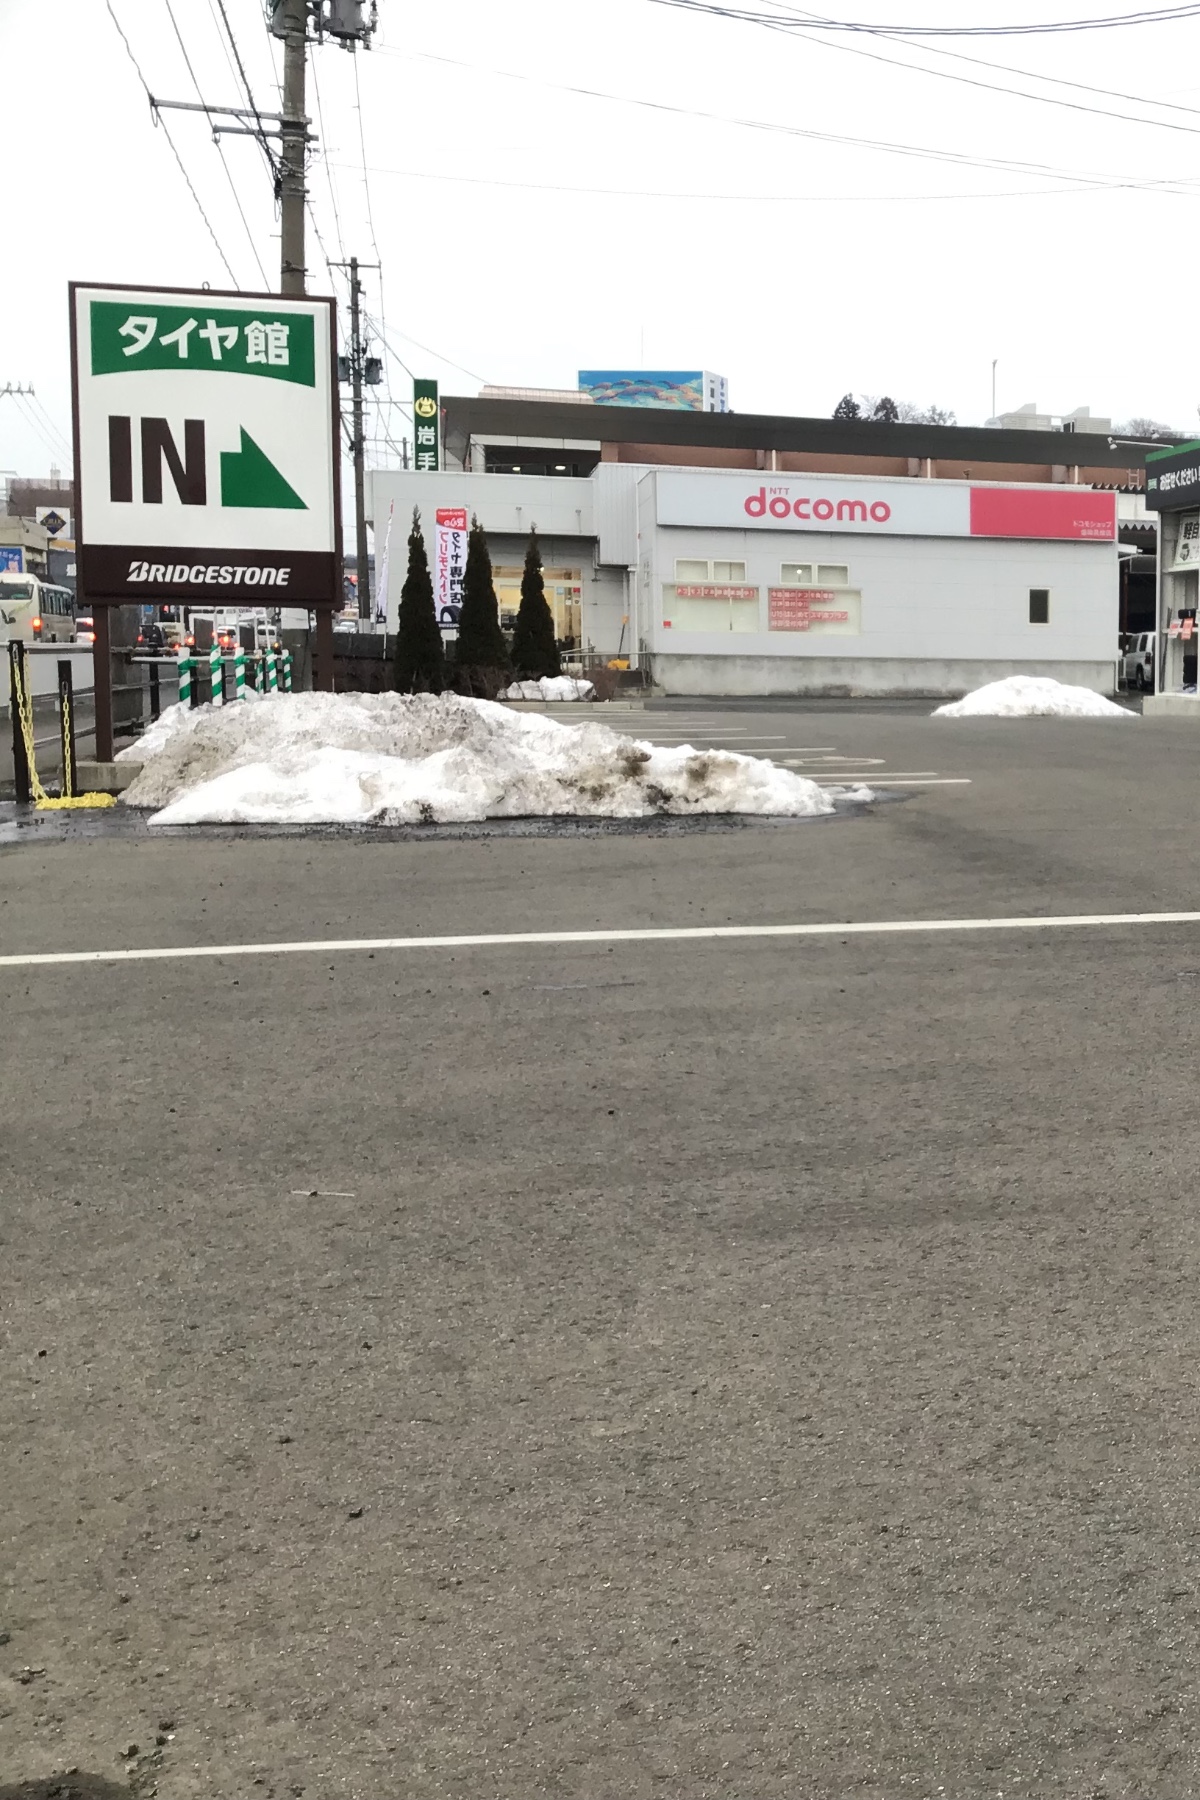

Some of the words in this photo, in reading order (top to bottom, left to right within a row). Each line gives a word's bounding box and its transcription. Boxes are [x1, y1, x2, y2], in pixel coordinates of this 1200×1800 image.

[118, 315, 290, 366] タイヤ館
[108, 415, 207, 506] IN
[744, 487, 891, 523] docomo
[769, 487, 791, 495] NTT
[126, 560, 291, 586] BRIDGESTONE
